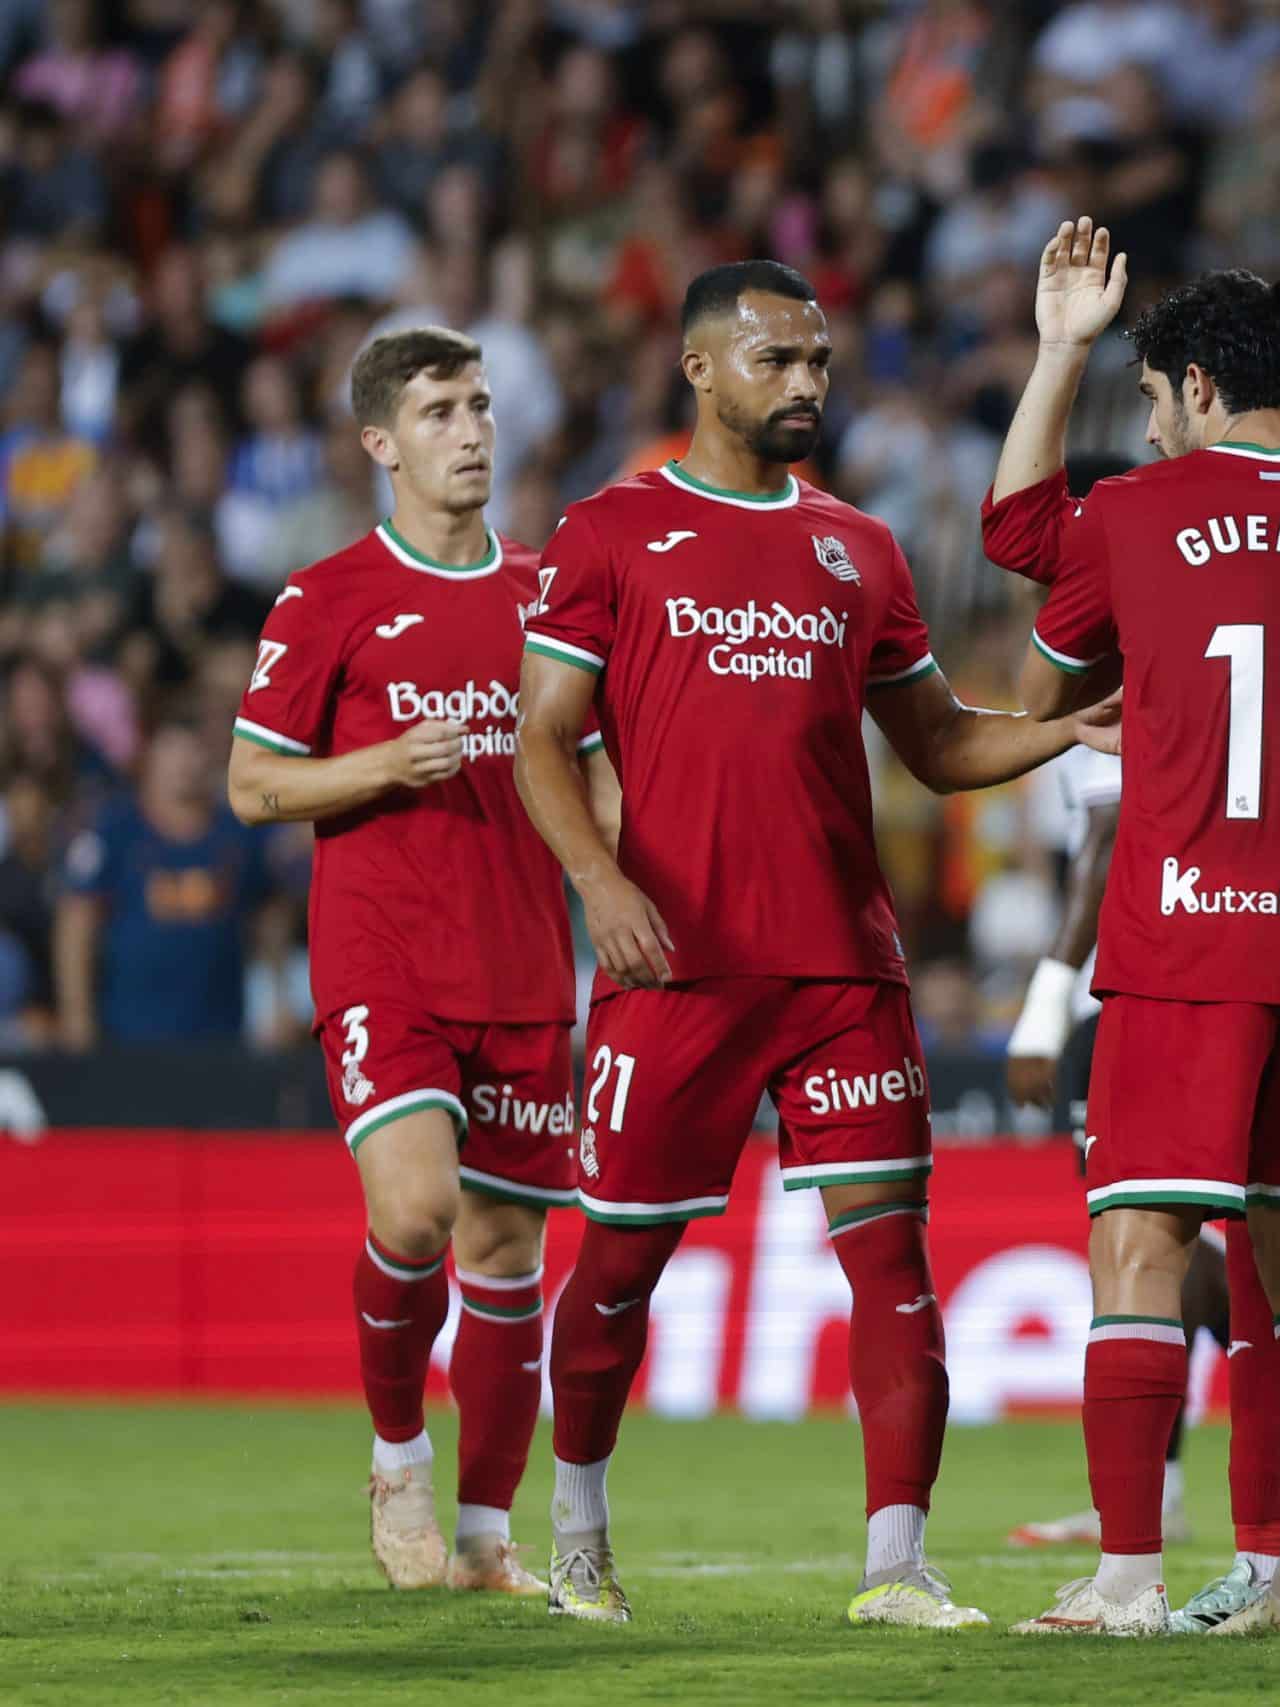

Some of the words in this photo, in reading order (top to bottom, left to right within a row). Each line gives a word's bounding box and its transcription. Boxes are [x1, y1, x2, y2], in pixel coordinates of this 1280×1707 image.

[665, 597, 849, 649] Baghdadi
[708, 644, 812, 682] Capital
[386, 679, 520, 724] Baghd
[342, 1004, 369, 1064] 3
[470, 1084, 575, 1136] Siweb
[587, 1045, 635, 1133] 21
[805, 1057, 926, 1116] Siweb
